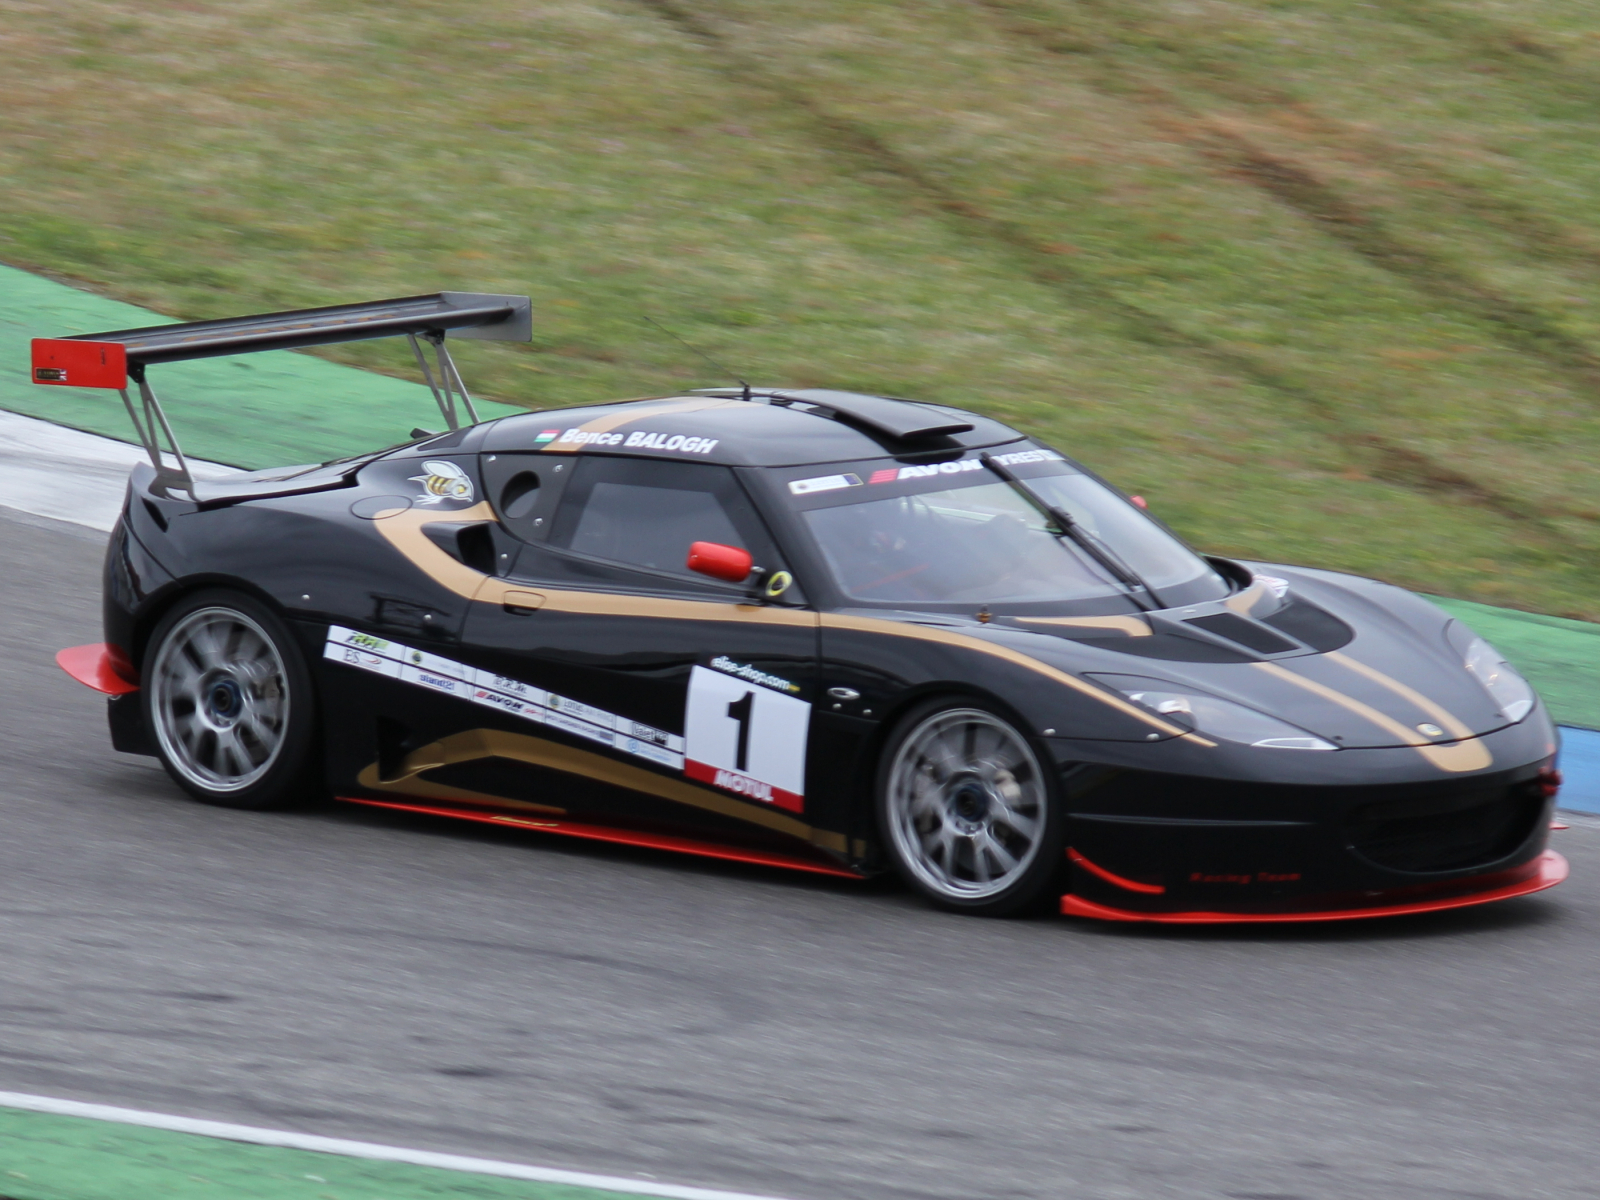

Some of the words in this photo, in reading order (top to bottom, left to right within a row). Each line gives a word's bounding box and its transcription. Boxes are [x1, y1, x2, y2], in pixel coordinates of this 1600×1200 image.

[558, 428, 624, 446] Bence
[623, 431, 720, 454] BALOGH
[897, 458, 985, 480] AVON
[485, 693, 525, 711] AVON
[725, 690, 756, 773] 1
[713, 769, 774, 802] MOTUL
